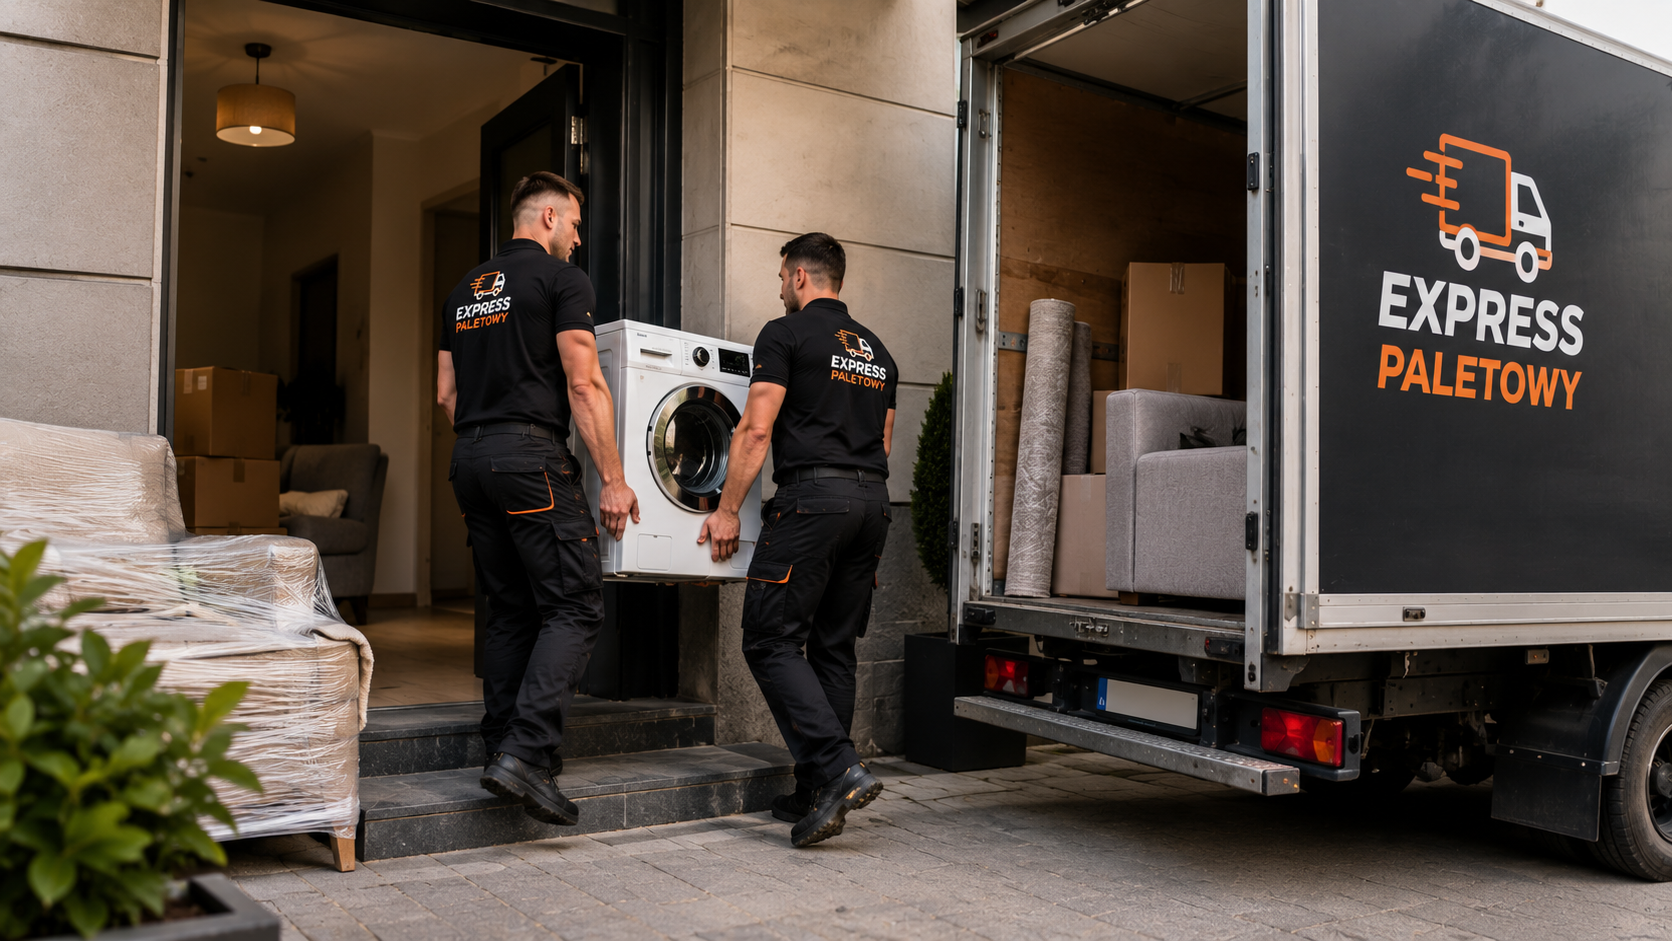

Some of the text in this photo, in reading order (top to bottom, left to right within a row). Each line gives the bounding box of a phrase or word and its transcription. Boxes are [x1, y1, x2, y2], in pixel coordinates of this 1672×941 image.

[456, 296, 511, 321] EXPRESS
[1378, 270, 1584, 356] EXPRESS
[455, 312, 509, 333] PALETOWY
[831, 355, 886, 380] EXPRESS
[1377, 344, 1583, 410] PALETOWY
[831, 370, 885, 391] PALETOWY
